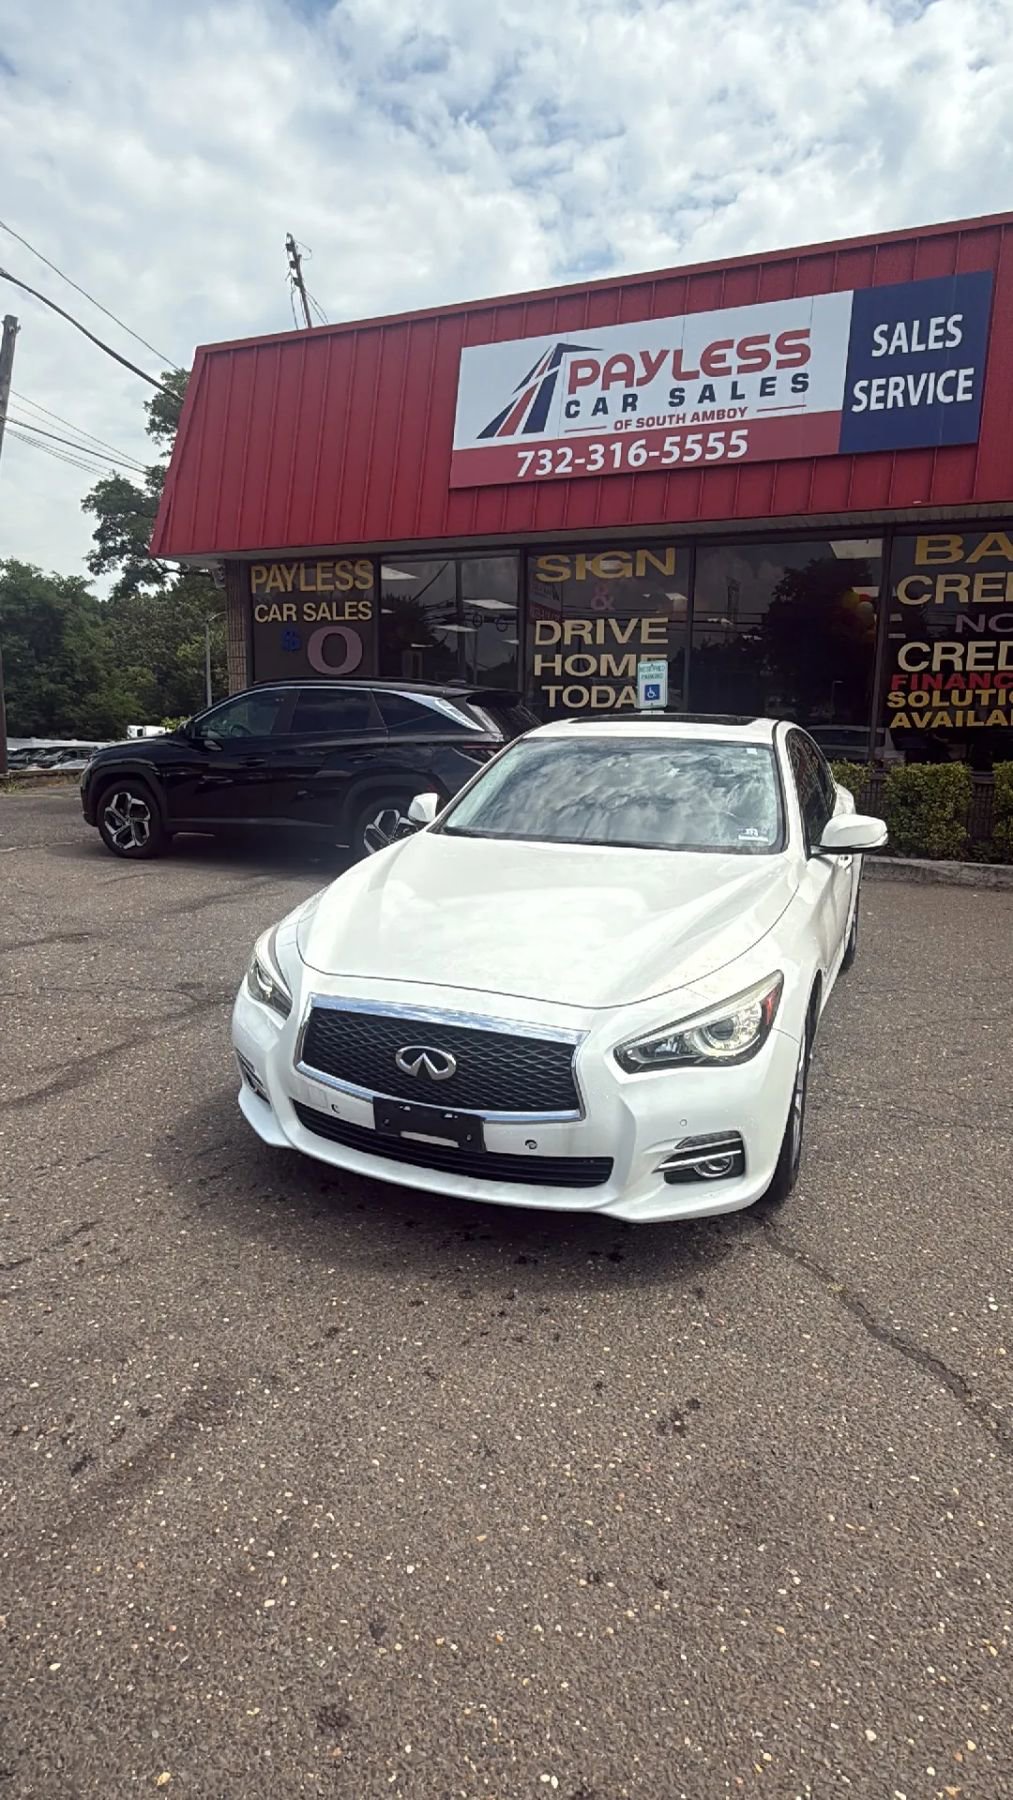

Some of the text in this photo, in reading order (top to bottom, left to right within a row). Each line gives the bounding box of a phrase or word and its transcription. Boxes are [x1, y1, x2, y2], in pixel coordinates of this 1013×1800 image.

[871, 314, 963, 357] SALES
[567, 328, 811, 395] PAYLESS
[564, 372, 810, 419] CAR SALES
[851, 367, 975, 413] SERVICE
[614, 406, 749, 431] OF SOUTH AMBOY
[516, 429, 749, 477] 732-316-5555
[250, 560, 374, 593] PAYLESS
[535, 547, 677, 583] SIGN
[254, 601, 372, 622] CAR SALES
[534, 617, 669, 646] DRIVE
[534, 653, 668, 677] HOM
[541, 685, 640, 709] TODA
[887, 689, 1013, 708] SOLUTI
[889, 710, 1013, 729] AVAILA
